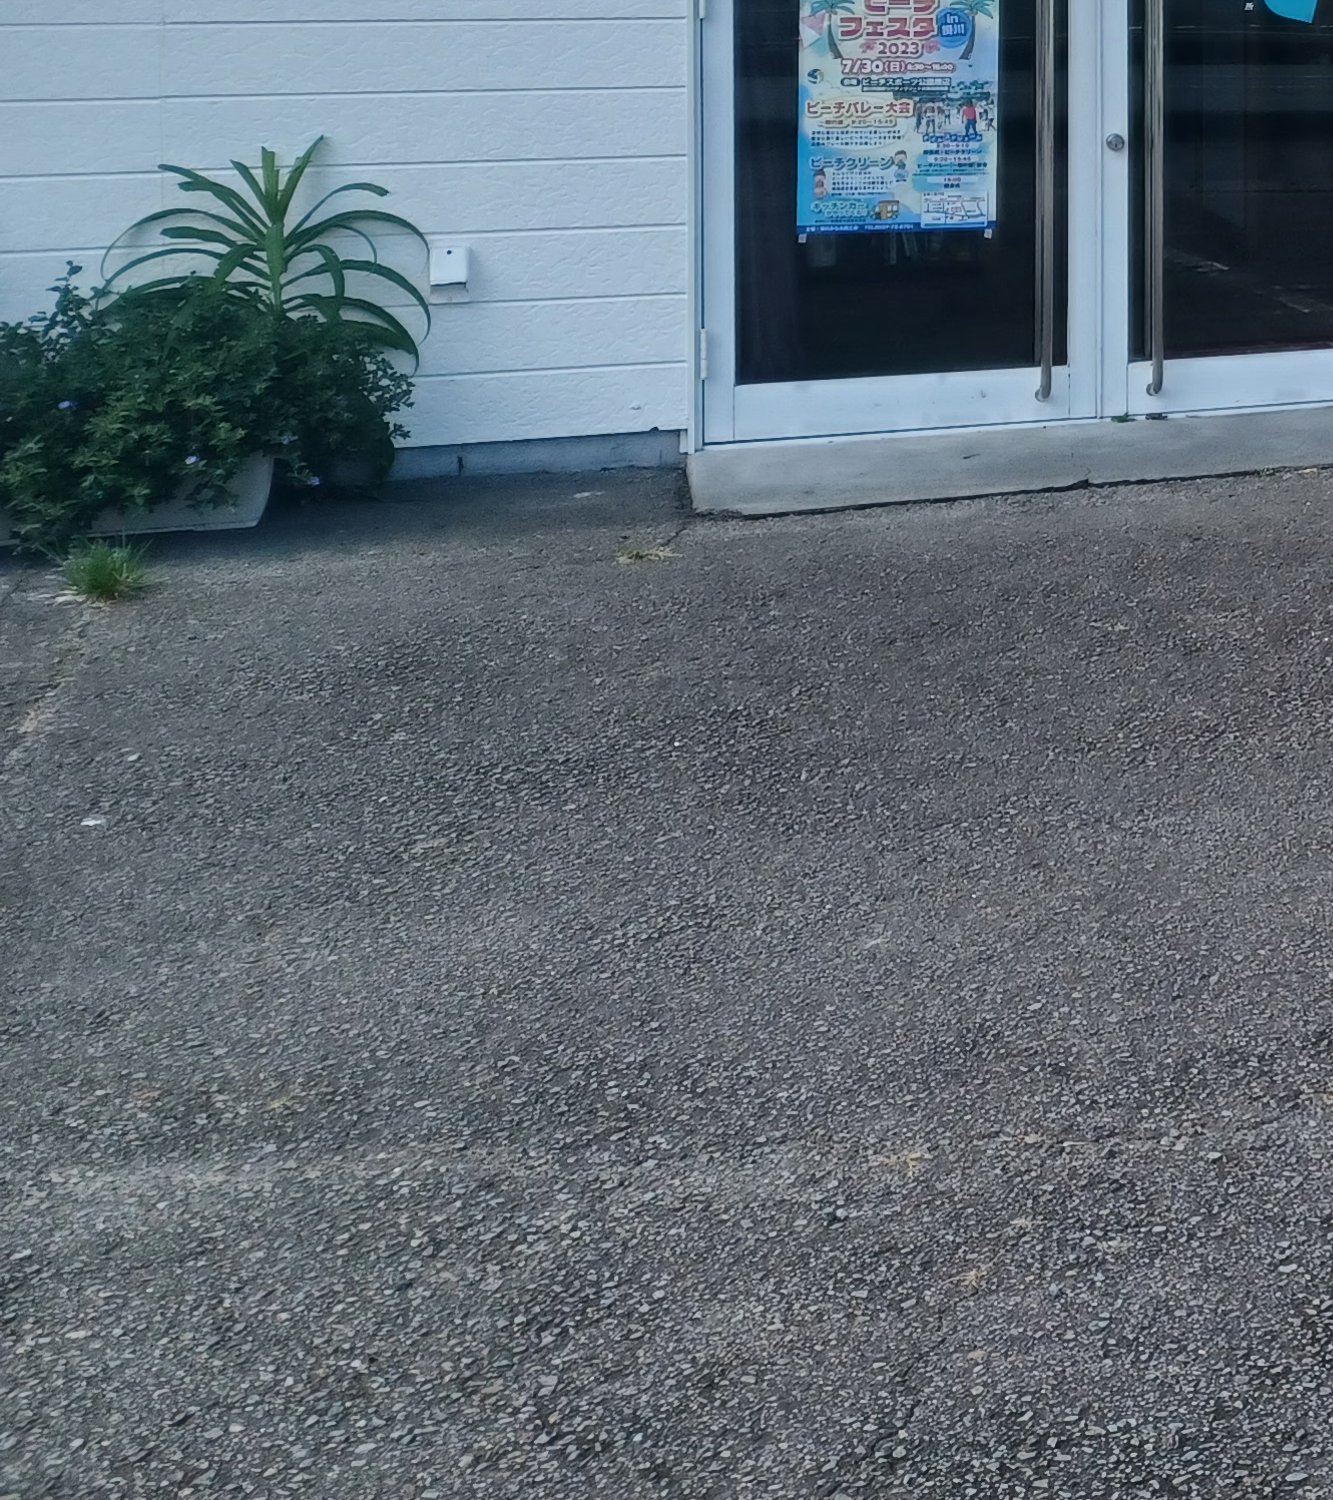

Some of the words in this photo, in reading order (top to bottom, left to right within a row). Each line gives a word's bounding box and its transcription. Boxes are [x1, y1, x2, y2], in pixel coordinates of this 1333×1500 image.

[840, 17, 936, 37] フェスタ
[878, 41, 920, 55] 2023
[807, 101, 911, 115] ビーチバレー大会
[810, 156, 895, 169] ビーチクリーン
